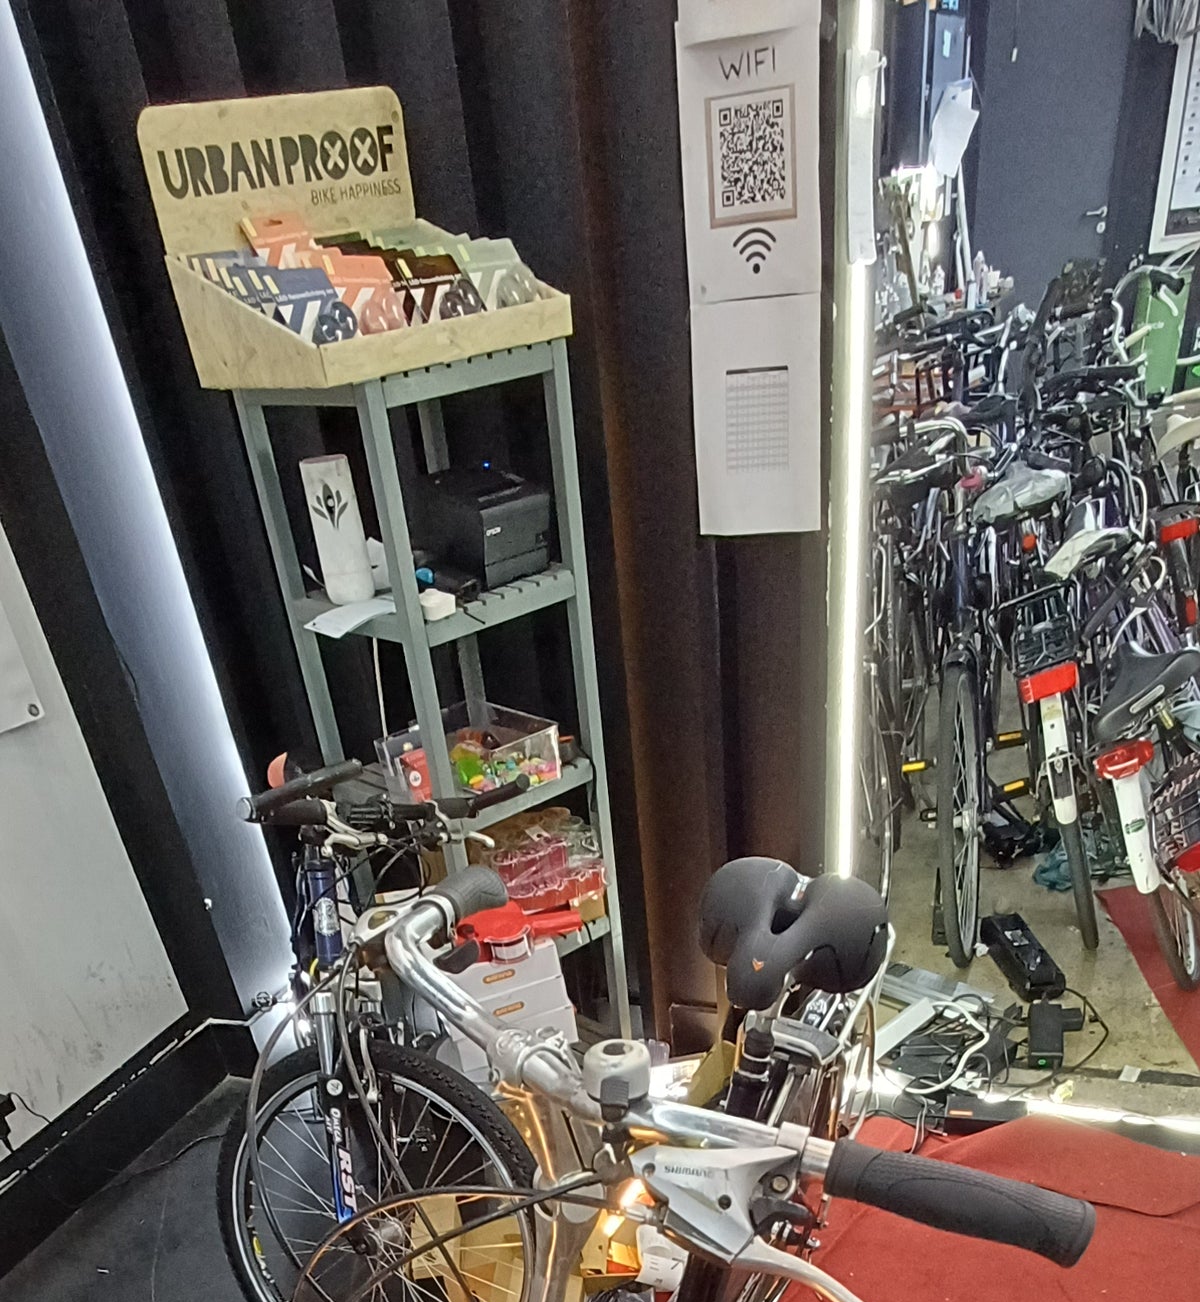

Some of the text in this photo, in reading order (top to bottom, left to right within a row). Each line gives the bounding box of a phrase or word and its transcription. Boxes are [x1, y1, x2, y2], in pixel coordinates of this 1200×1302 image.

[718, 46, 776, 81] WIFI
[311, 178, 401, 206] BIKE HAPPINESS
[338, 1147, 358, 1213] RST
